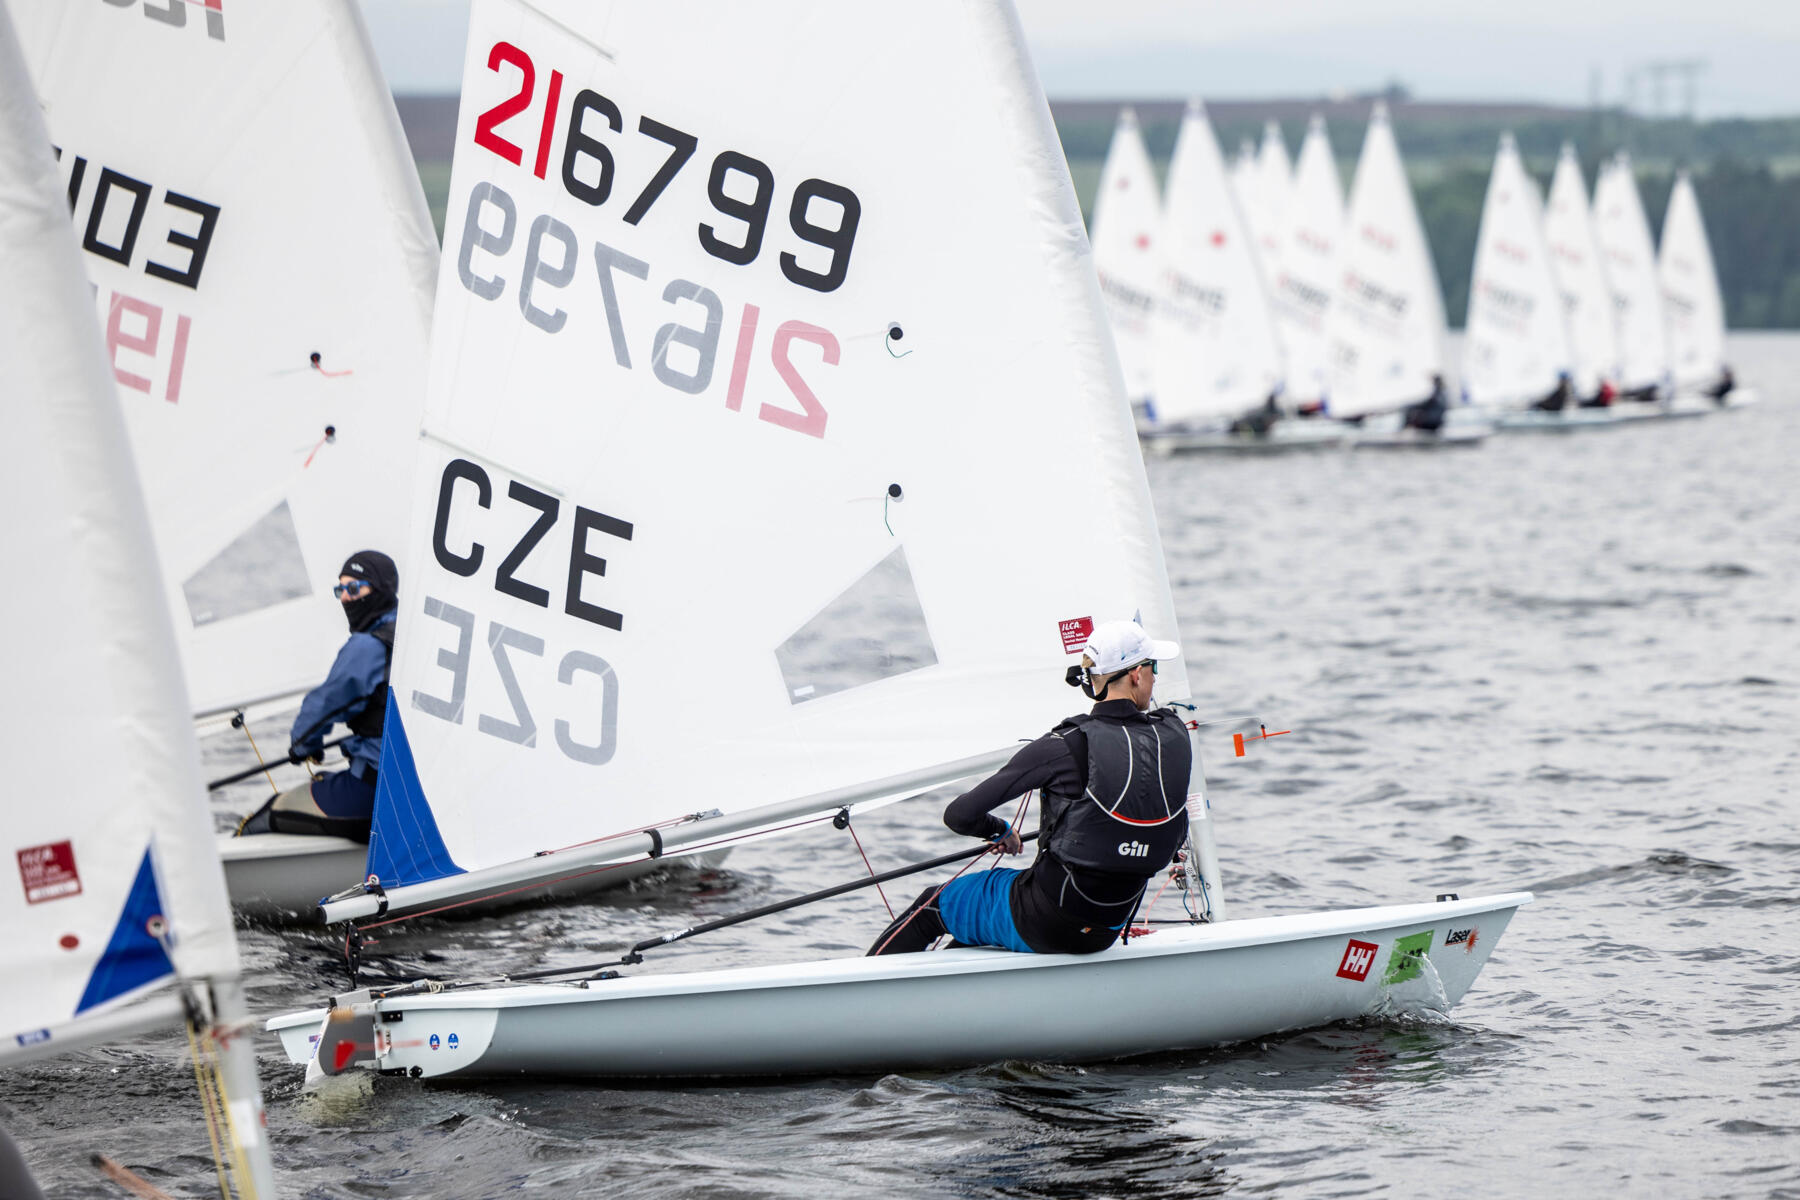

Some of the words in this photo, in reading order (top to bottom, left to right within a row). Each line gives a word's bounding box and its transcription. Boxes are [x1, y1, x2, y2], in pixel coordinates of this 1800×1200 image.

[474, 41, 862, 293] 216799
[51, 144, 221, 290] 103
[432, 458, 634, 632] CZE
[1062, 621, 1080, 631] ILCA
[1118, 841, 1149, 857] Gill
[1445, 929, 1471, 944] Laser
[1343, 947, 1372, 974] HH
